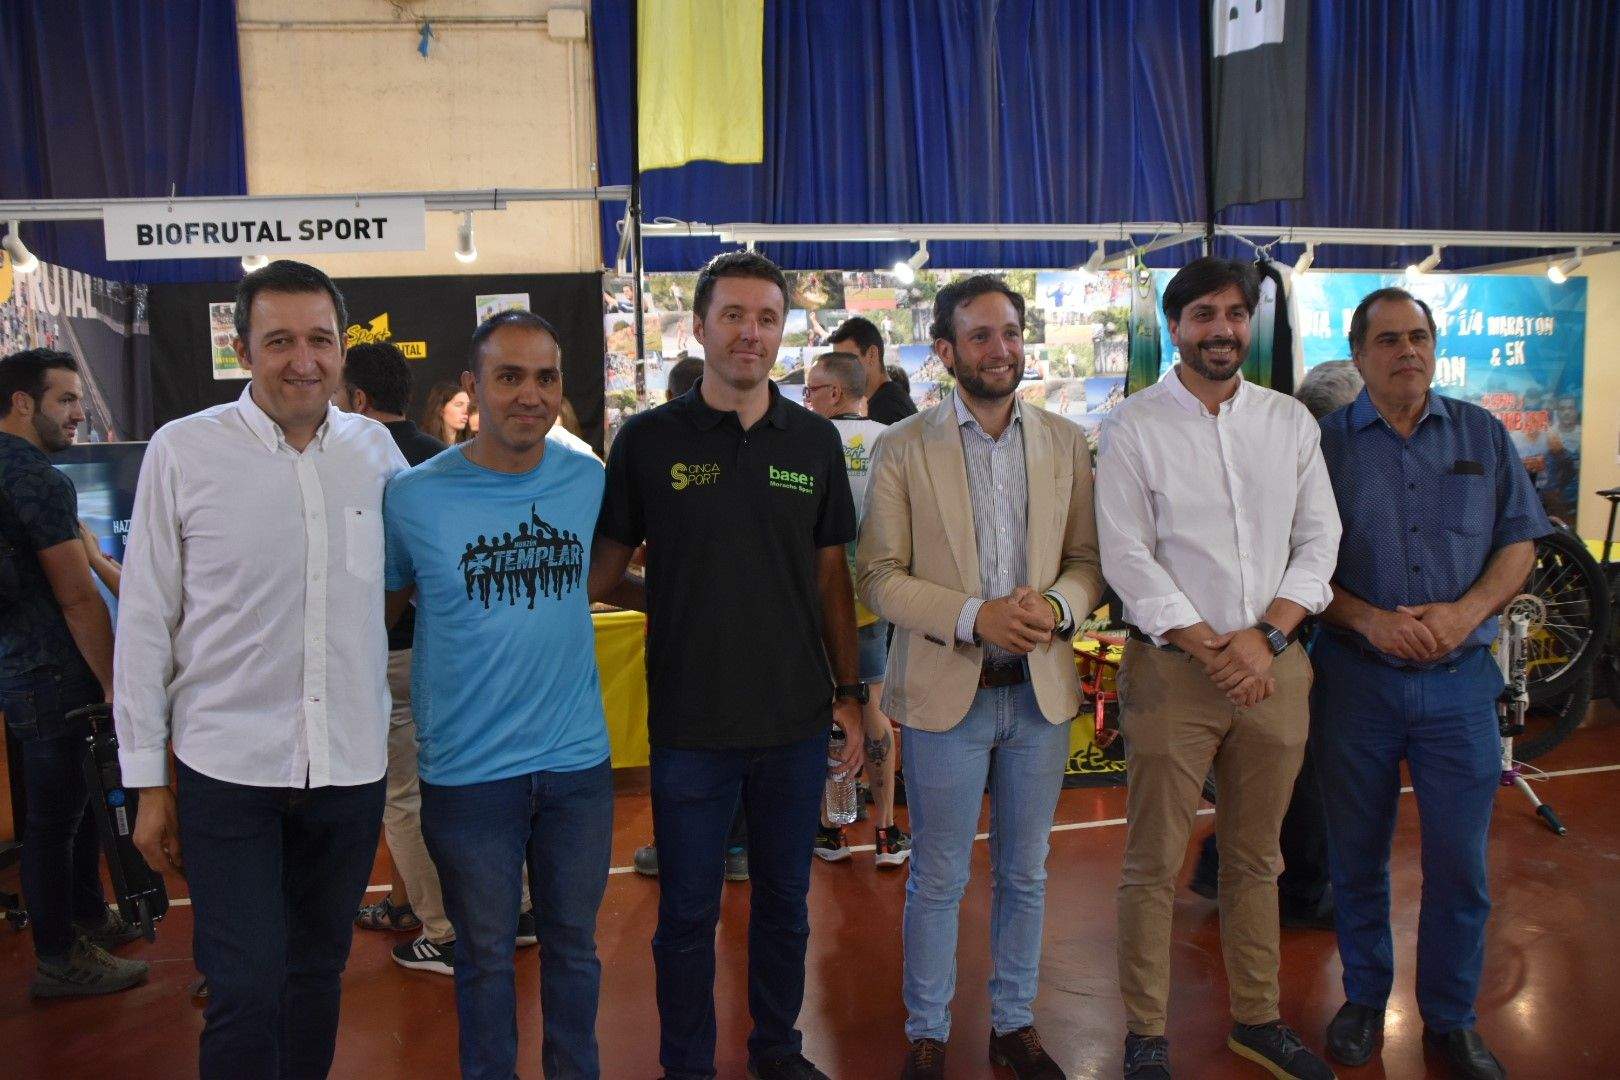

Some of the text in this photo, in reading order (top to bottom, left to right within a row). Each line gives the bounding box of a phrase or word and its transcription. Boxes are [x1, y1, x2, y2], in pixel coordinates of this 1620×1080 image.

[136, 217, 388, 246] BIOFRUTAL SPORT
[1490, 340, 1525, 366] & 5K
[493, 545, 580, 573] TEMPLAR
